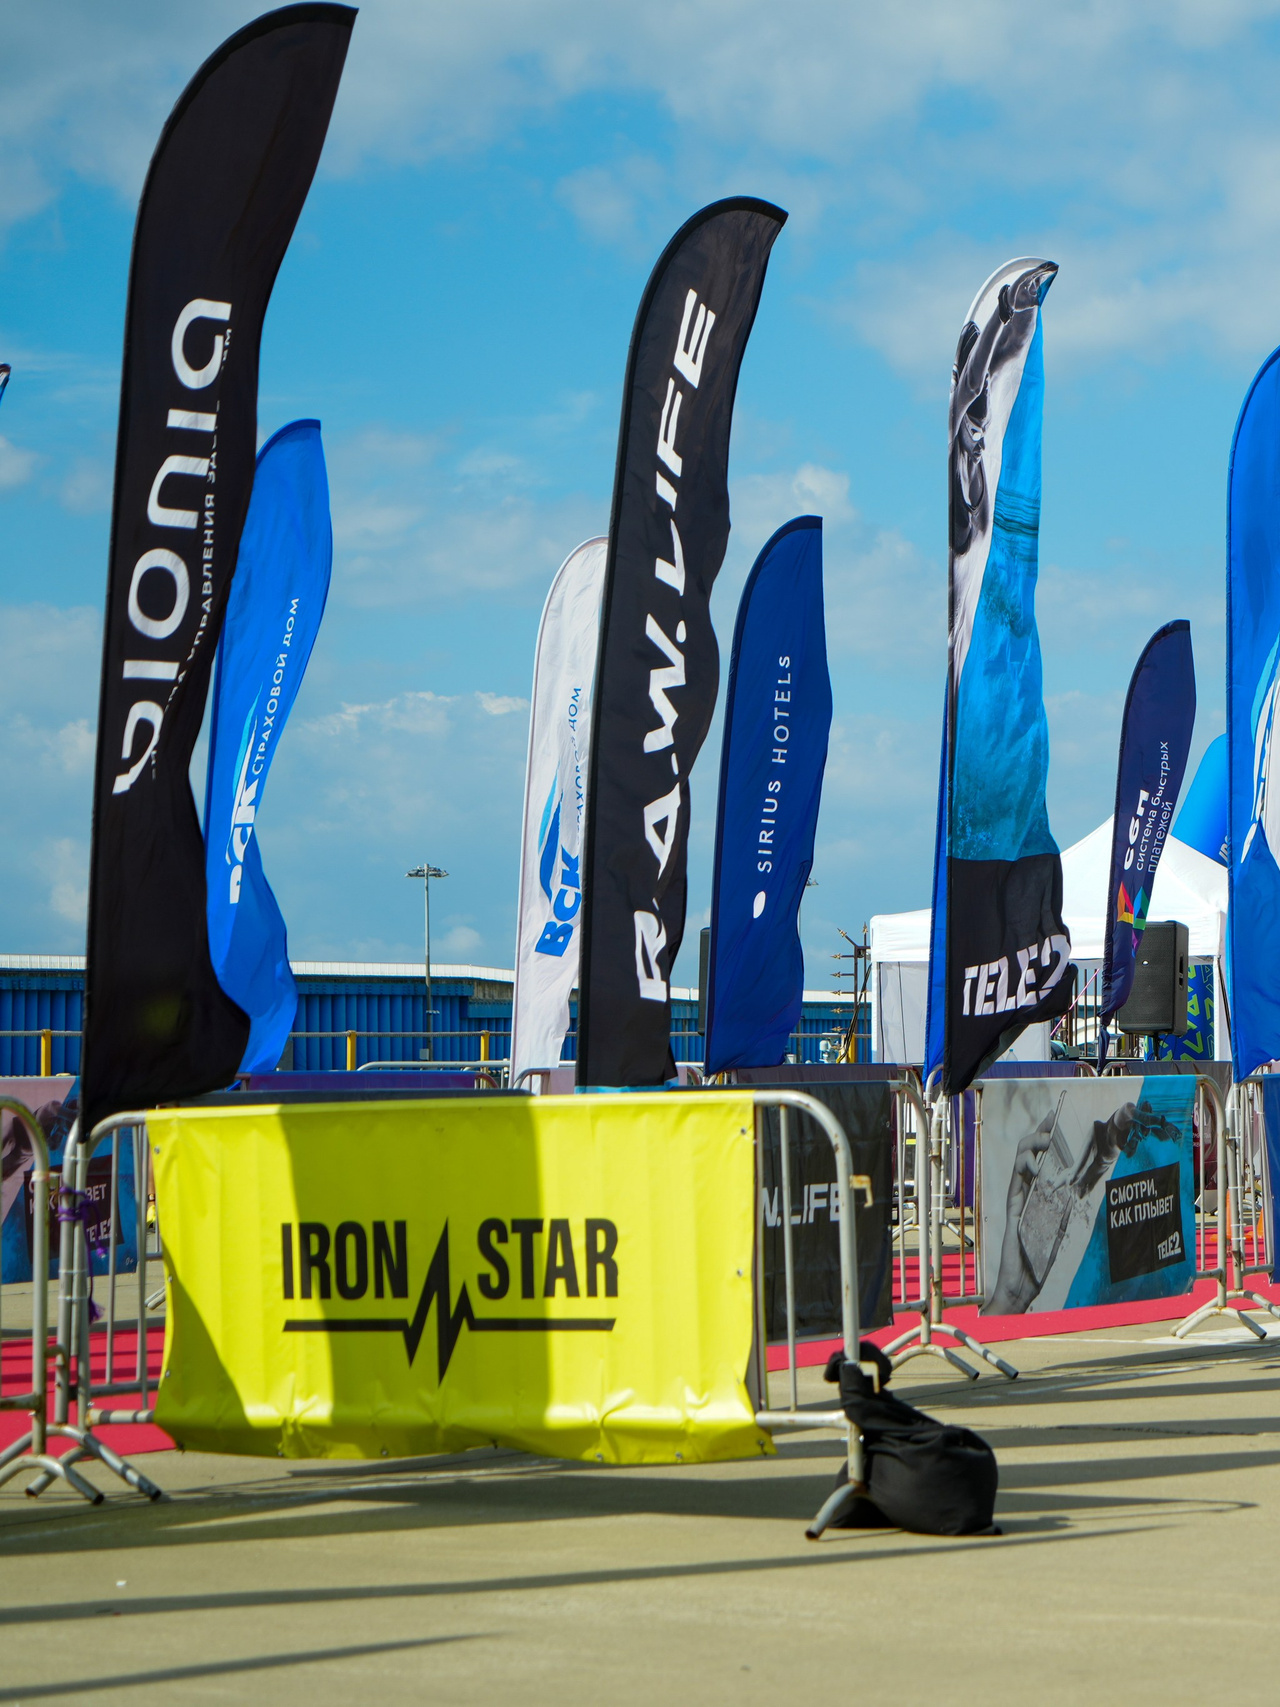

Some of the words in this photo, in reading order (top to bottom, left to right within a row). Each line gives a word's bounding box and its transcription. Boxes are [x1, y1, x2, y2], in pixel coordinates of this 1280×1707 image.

[252, 652, 288, 777] СТРАХОВОЙ
[281, 597, 300, 648] ДОМ
[567, 686, 582, 734] ДОМ
[756, 778, 782, 874] SIRIUS
[770, 654, 792, 764] HOTELS
[1136, 810, 1157, 871] система
[1150, 740, 1171, 807] быстрых
[1147, 801, 1174, 874] платежей
[534, 844, 583, 958] ВСК
[962, 933, 1072, 1016] TELE2
[1109, 1178, 1158, 1206] СМОТРИ,
[1110, 1207, 1133, 1229] КАК
[1134, 1194, 1175, 1223] ПЛЫВЕТ
[281, 1220, 409, 1300] IRON
[476, 1217, 619, 1300] STAR
[1157, 1231, 1182, 1260] TELE2
